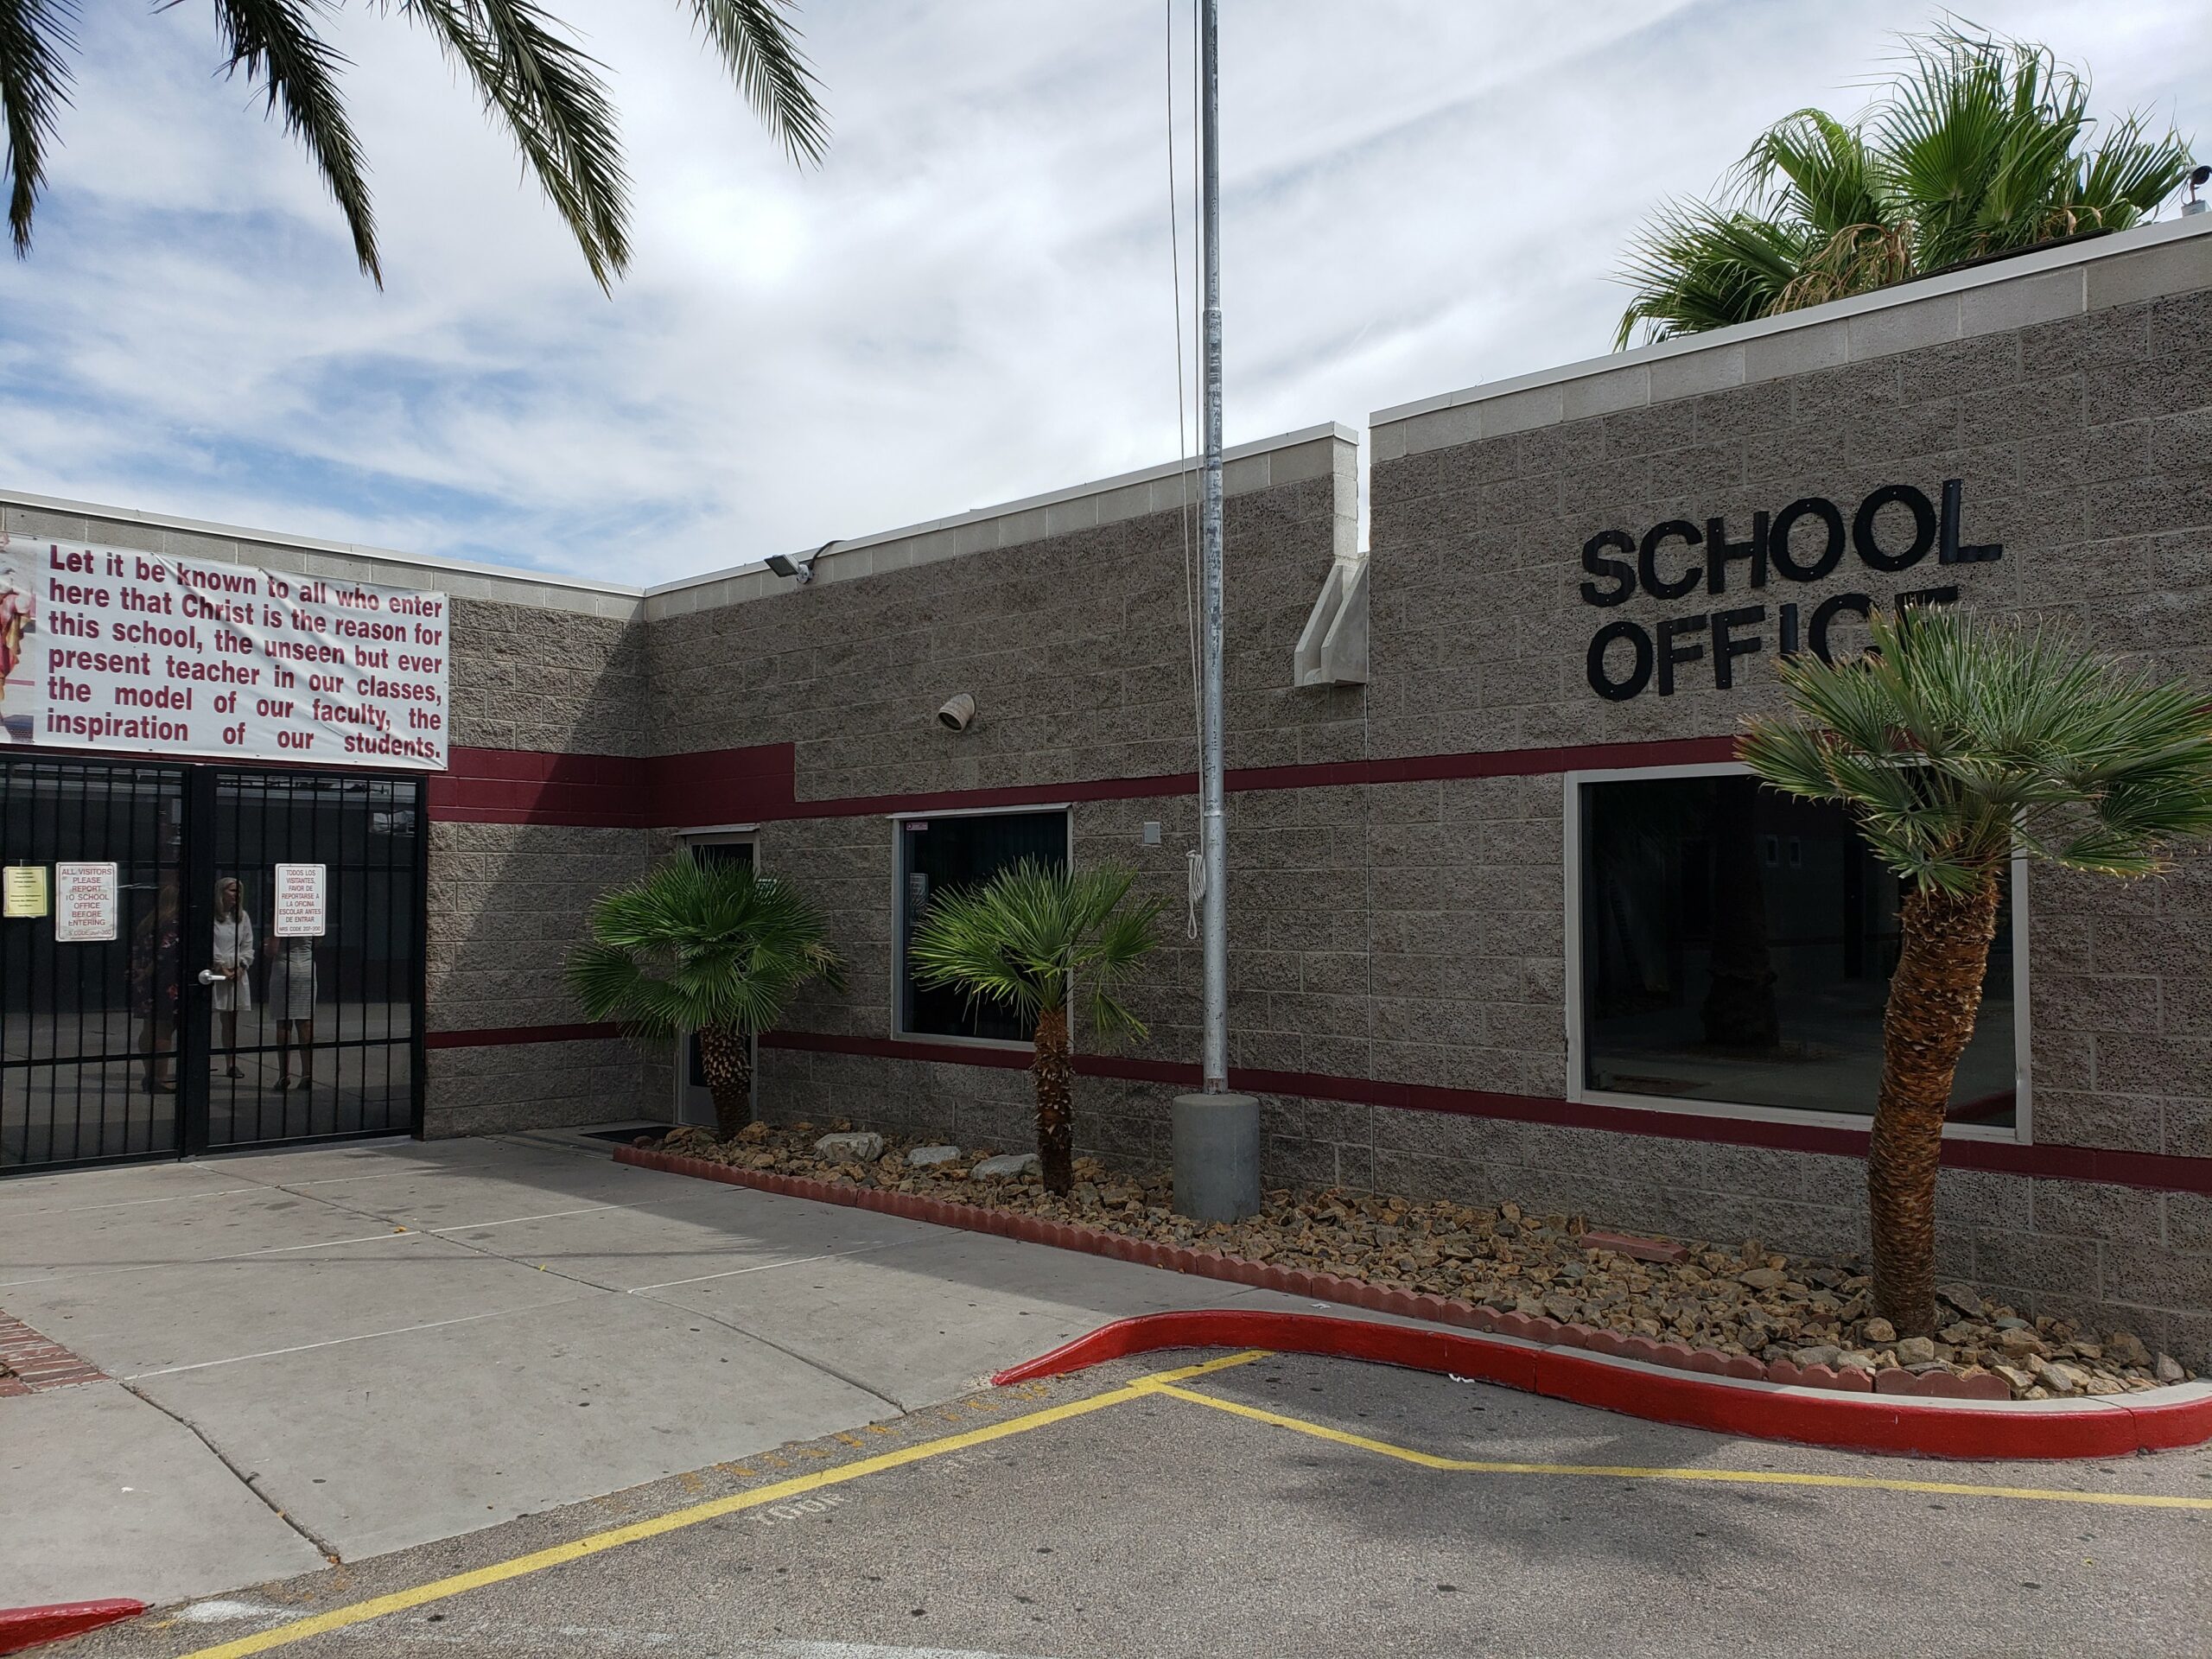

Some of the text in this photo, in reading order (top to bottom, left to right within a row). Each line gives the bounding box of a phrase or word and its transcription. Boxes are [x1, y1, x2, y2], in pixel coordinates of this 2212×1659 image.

[1580, 479, 2003, 607] SCHOOL
[49, 577, 442, 646] here that Christ is the reason for
[50, 544, 442, 618] Let it be known to all who enter
[49, 611, 442, 674] this school, the unseen but ever
[48, 649, 442, 705] present teacher in our classes,
[48, 677, 442, 732] the model of our faculty, the
[48, 708, 441, 759] inspiration of our students.
